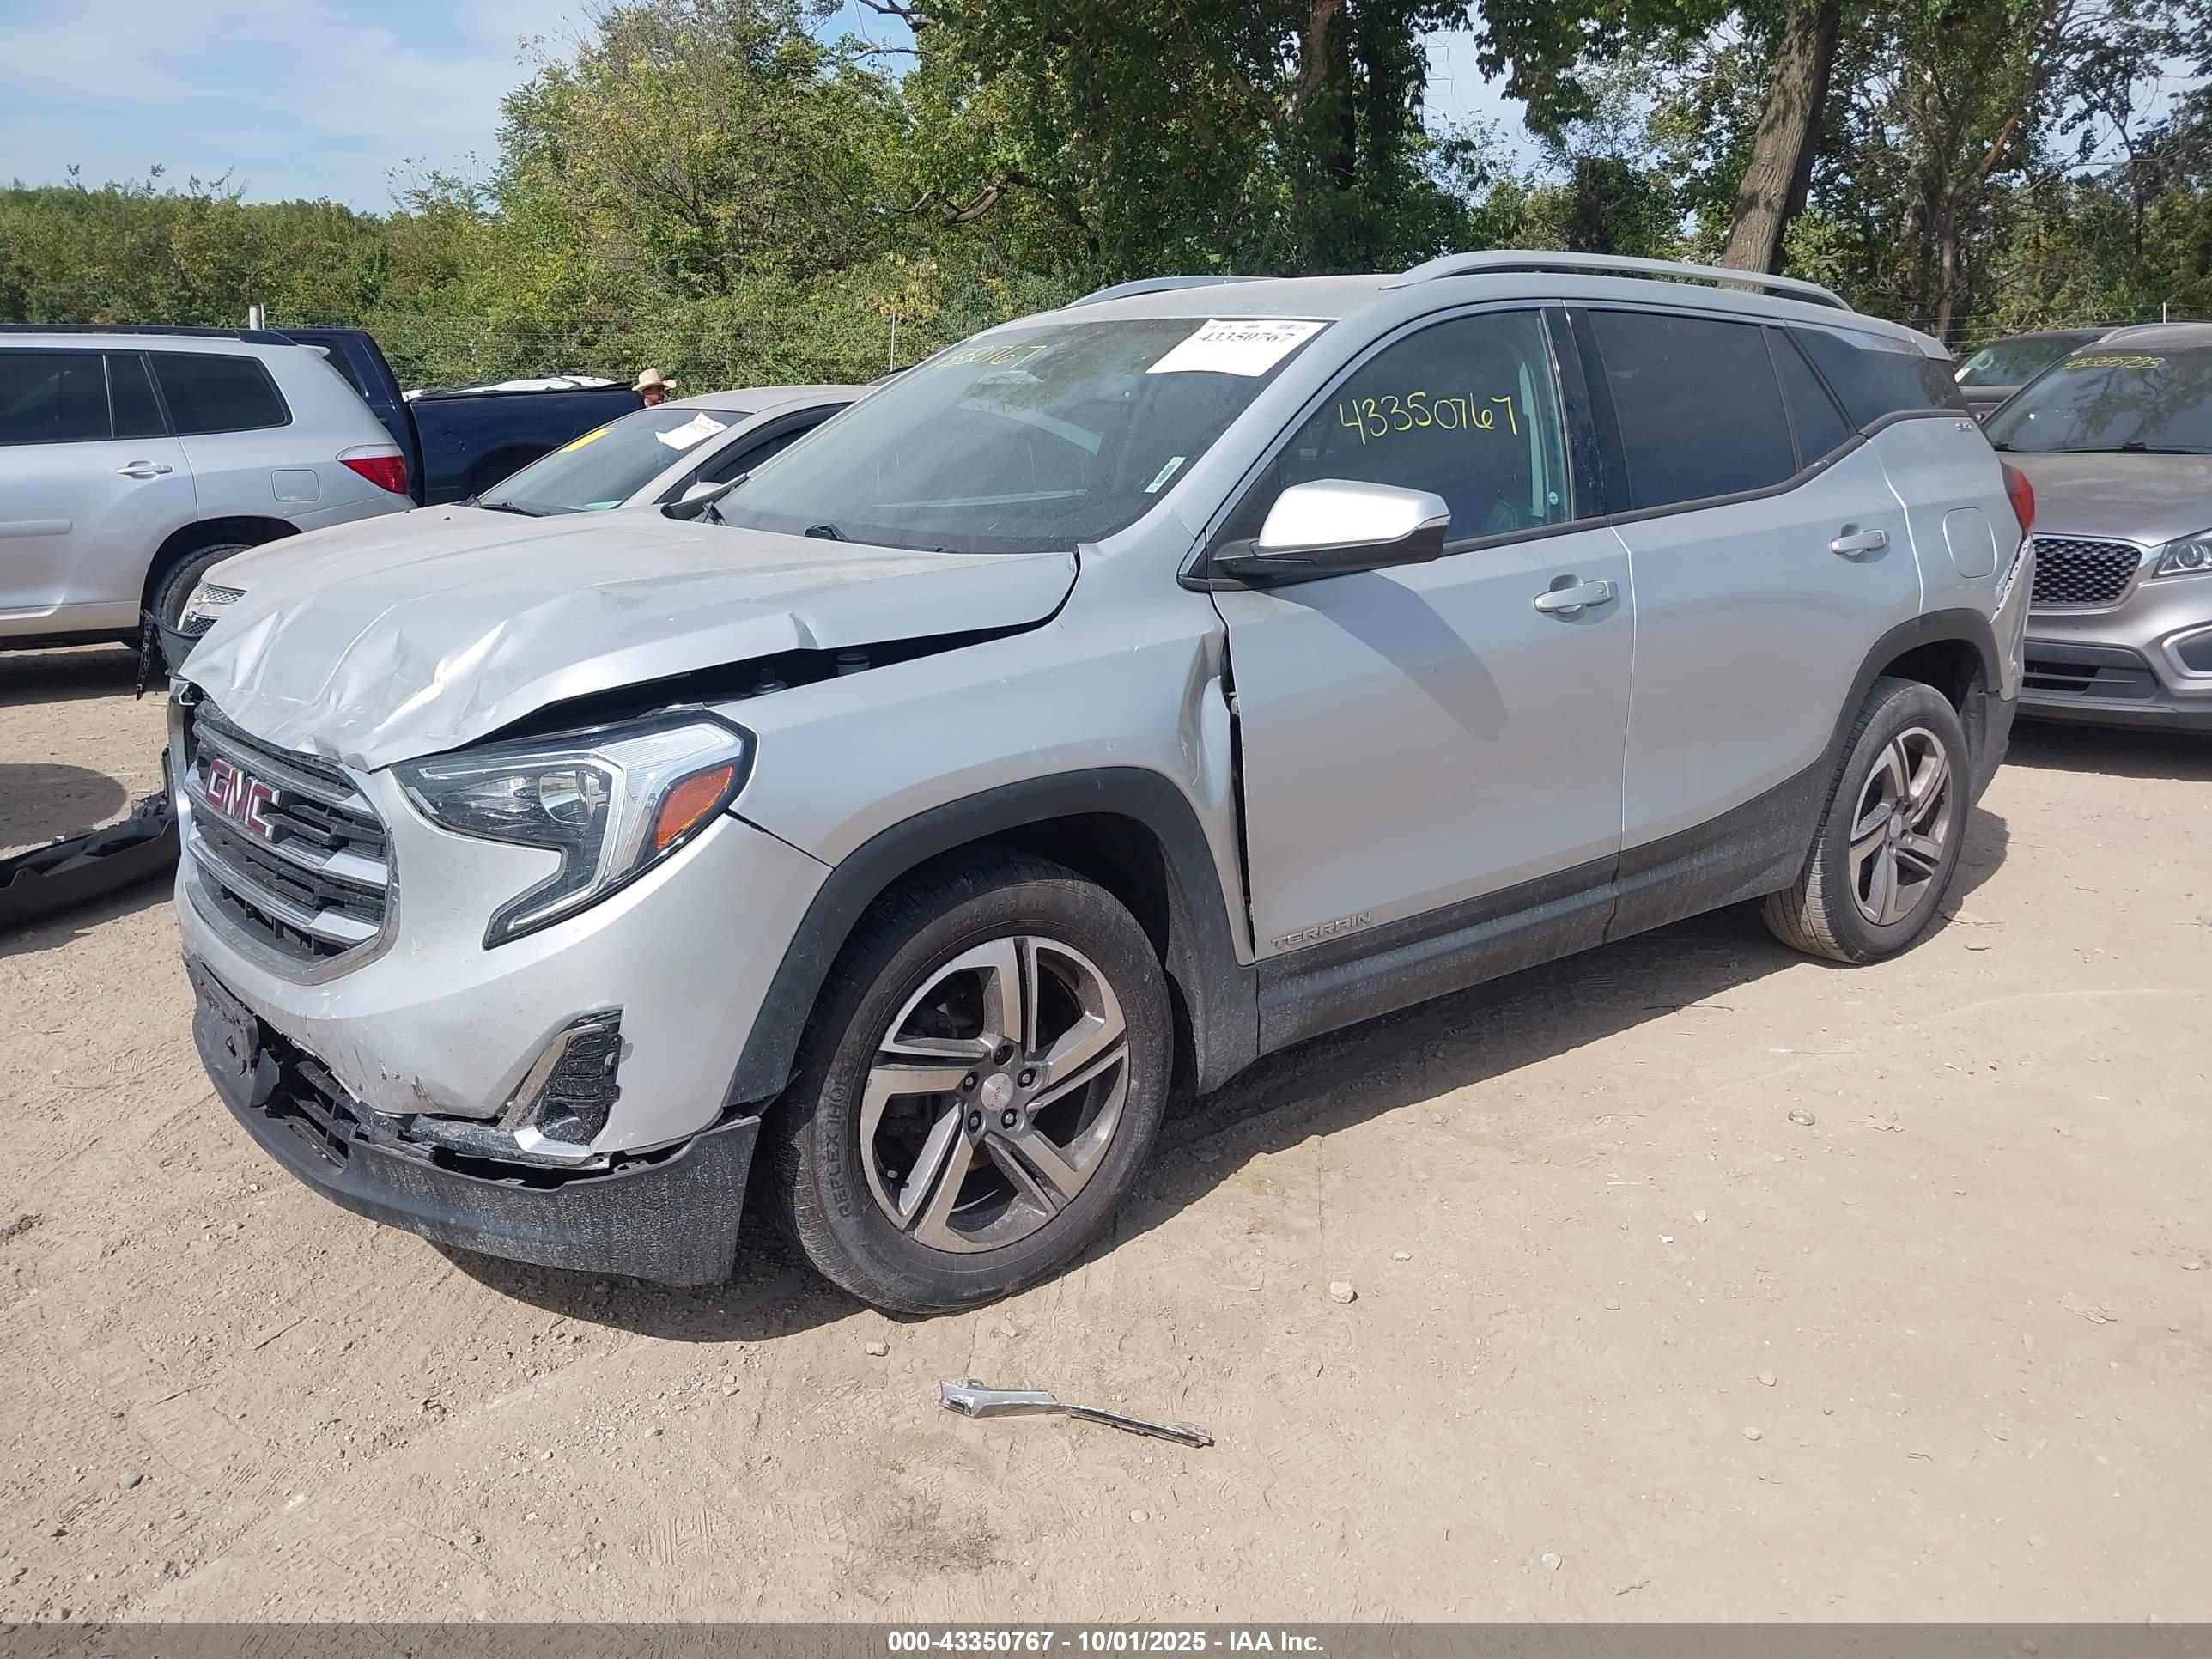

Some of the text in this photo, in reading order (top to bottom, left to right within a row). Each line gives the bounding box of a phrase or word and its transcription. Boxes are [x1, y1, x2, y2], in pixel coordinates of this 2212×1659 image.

[1199, 331, 1297, 343] 43350767
[1338, 391, 1518, 445] 43350767
[204, 758, 282, 842] GMC
[1270, 911, 1372, 950] TERRAIN
